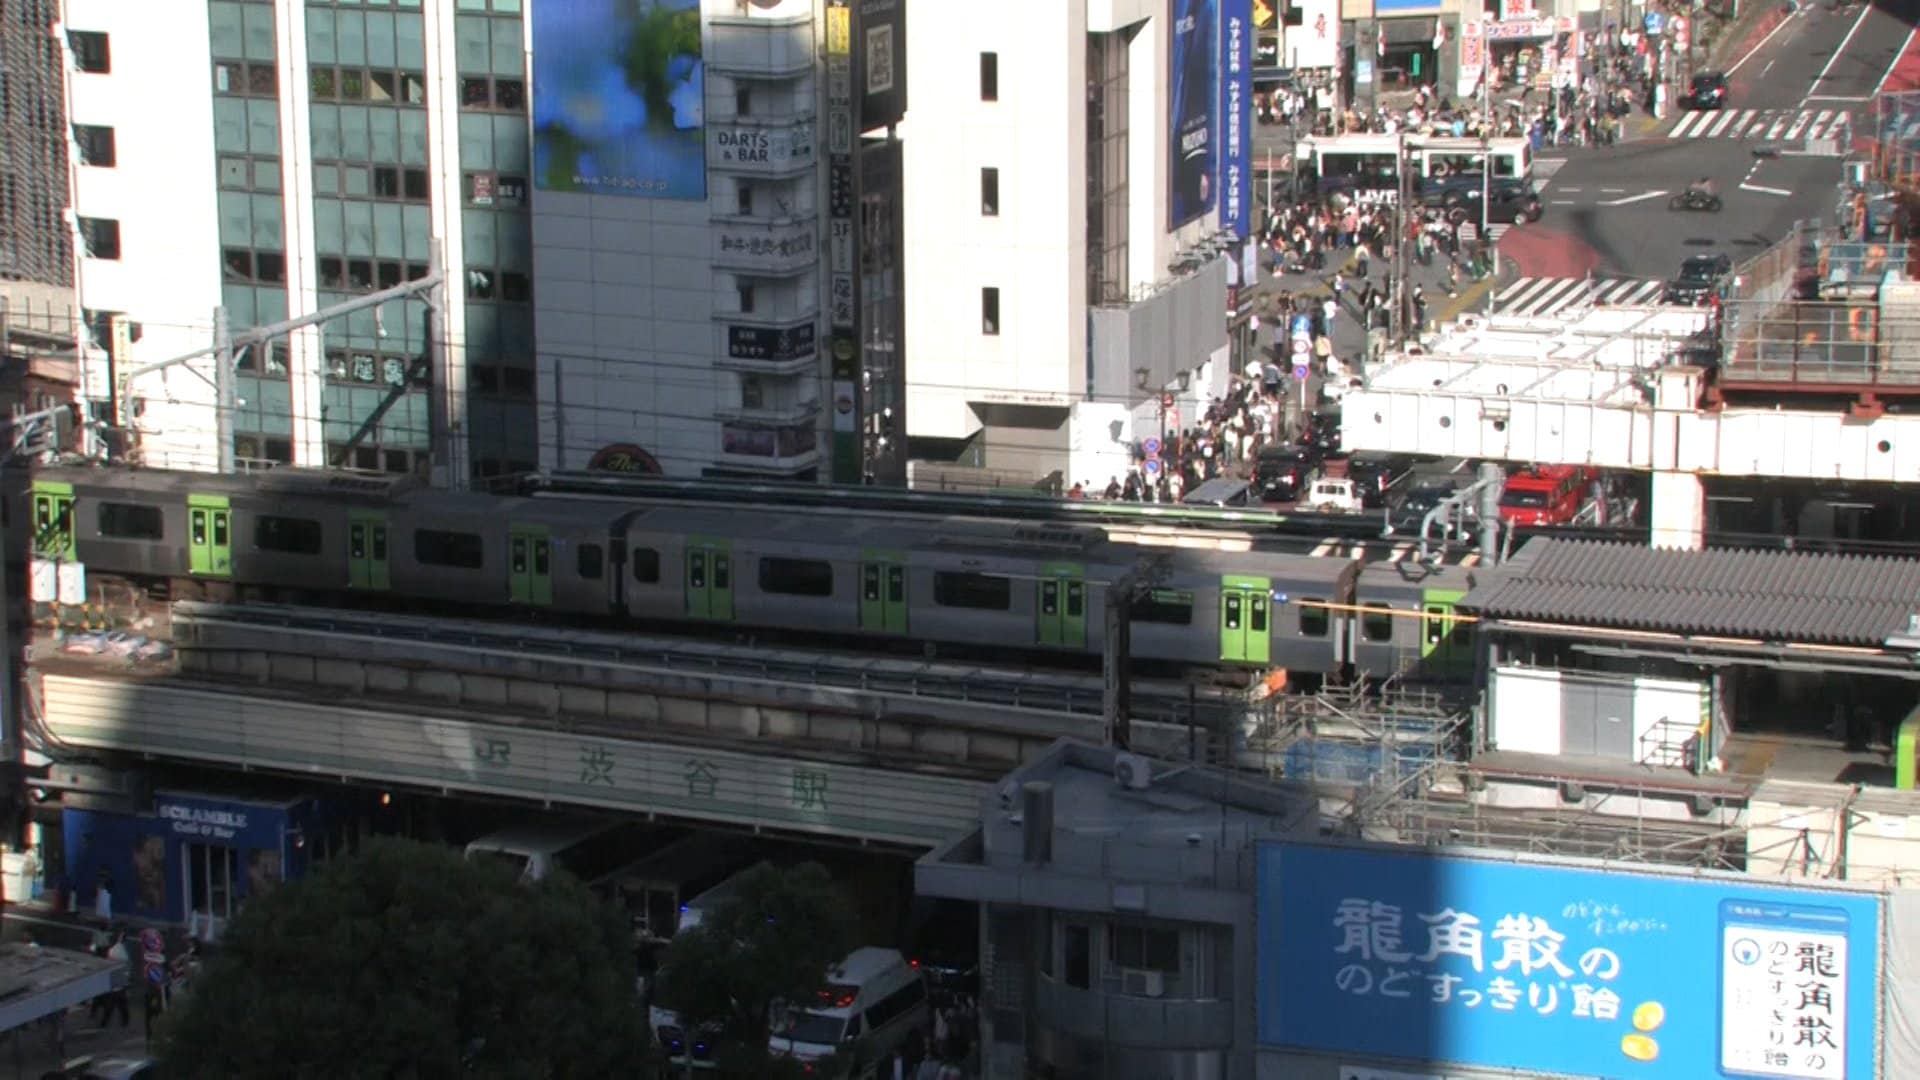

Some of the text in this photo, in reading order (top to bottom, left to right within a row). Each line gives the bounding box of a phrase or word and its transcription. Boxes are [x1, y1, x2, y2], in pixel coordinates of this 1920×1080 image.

[718, 132, 769, 148] DARTS
[738, 148, 769, 162] BAR
[159, 804, 248, 829] SCRAMBLE
[213, 826, 236, 839] Bar
[1333, 897, 1621, 980] 龍角散の
[1335, 963, 1622, 1021] のどすっきり飴
[1792, 941, 1840, 1071] 龍角散の
